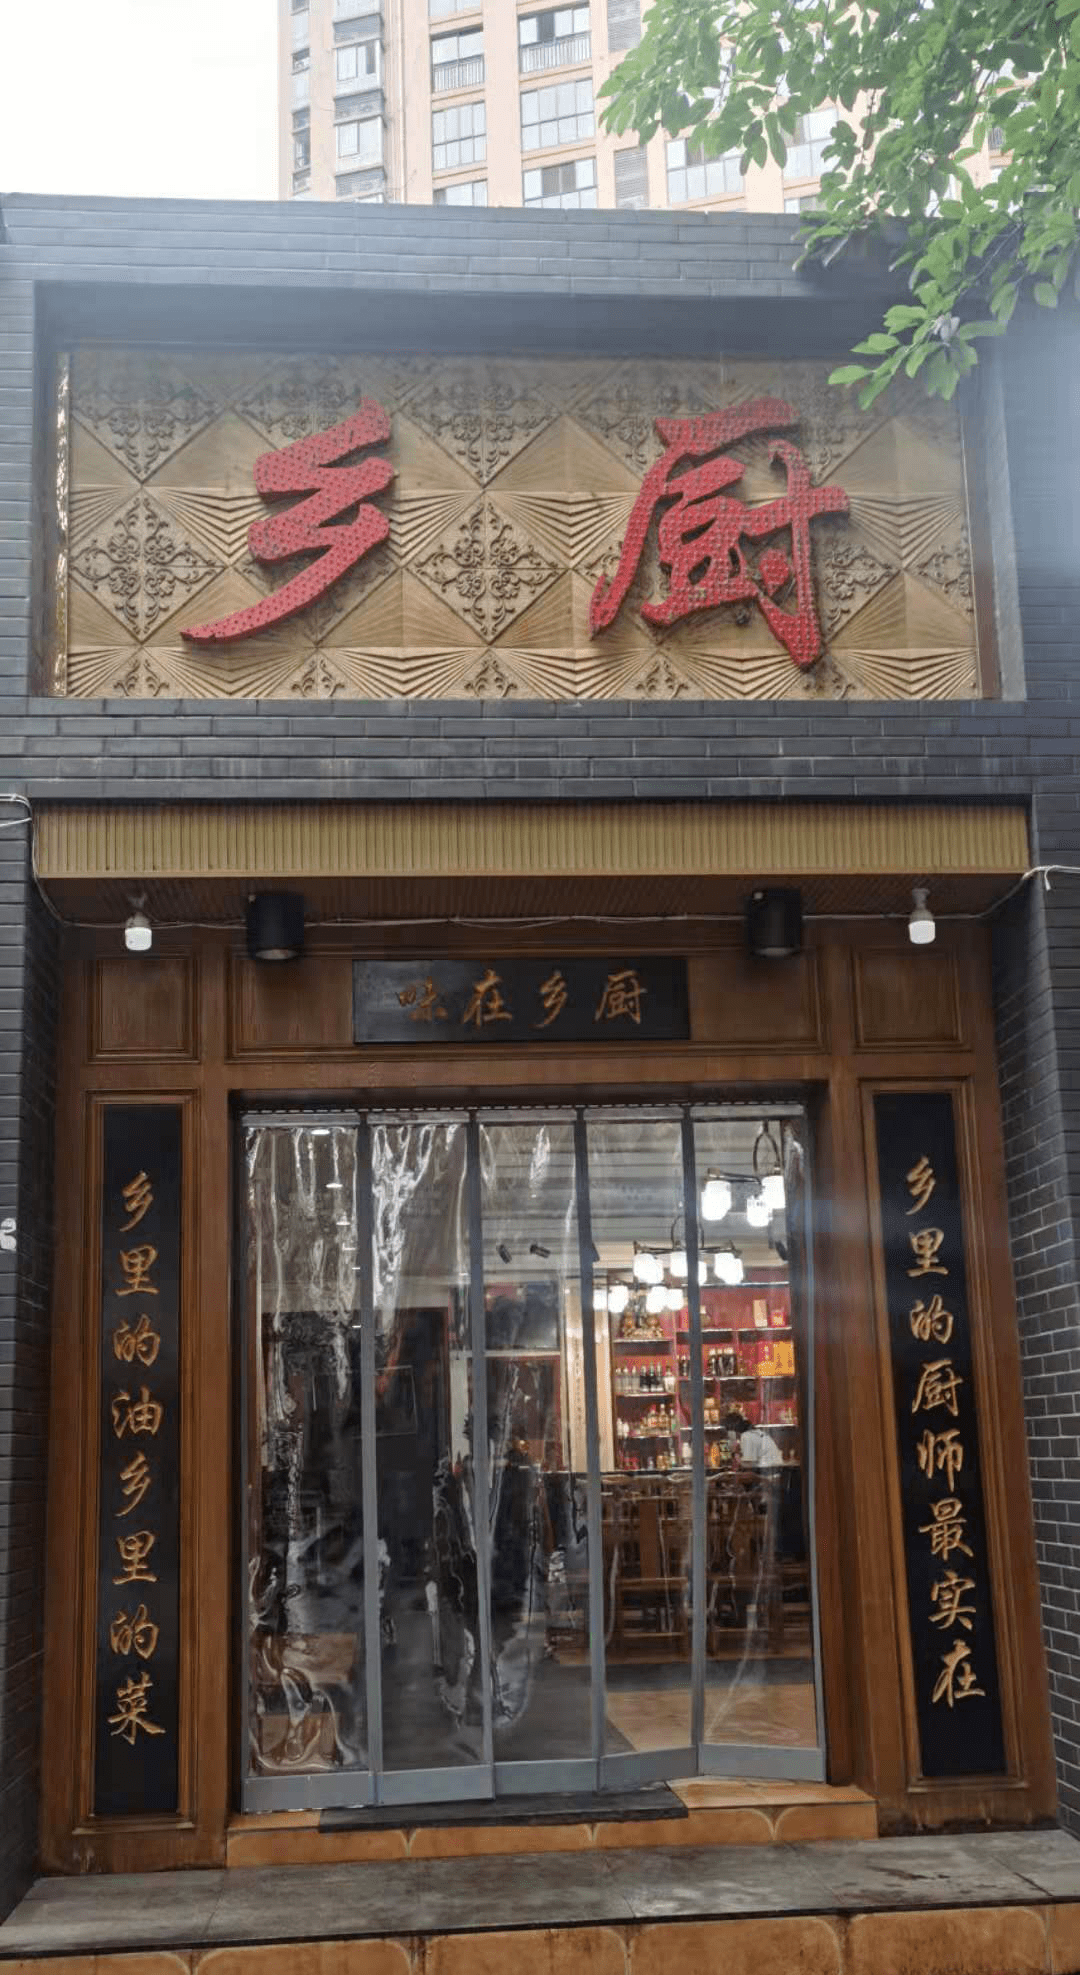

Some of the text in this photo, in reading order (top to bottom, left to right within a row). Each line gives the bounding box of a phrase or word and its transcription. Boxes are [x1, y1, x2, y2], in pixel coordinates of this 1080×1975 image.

[180, 396, 849, 667] 乡厨
[397, 968, 648, 1028] 味在乡厨
[107, 1171, 166, 1746] 乡里的油乡里的菜
[905, 1157, 987, 1708] 乡里的厨师最实在
